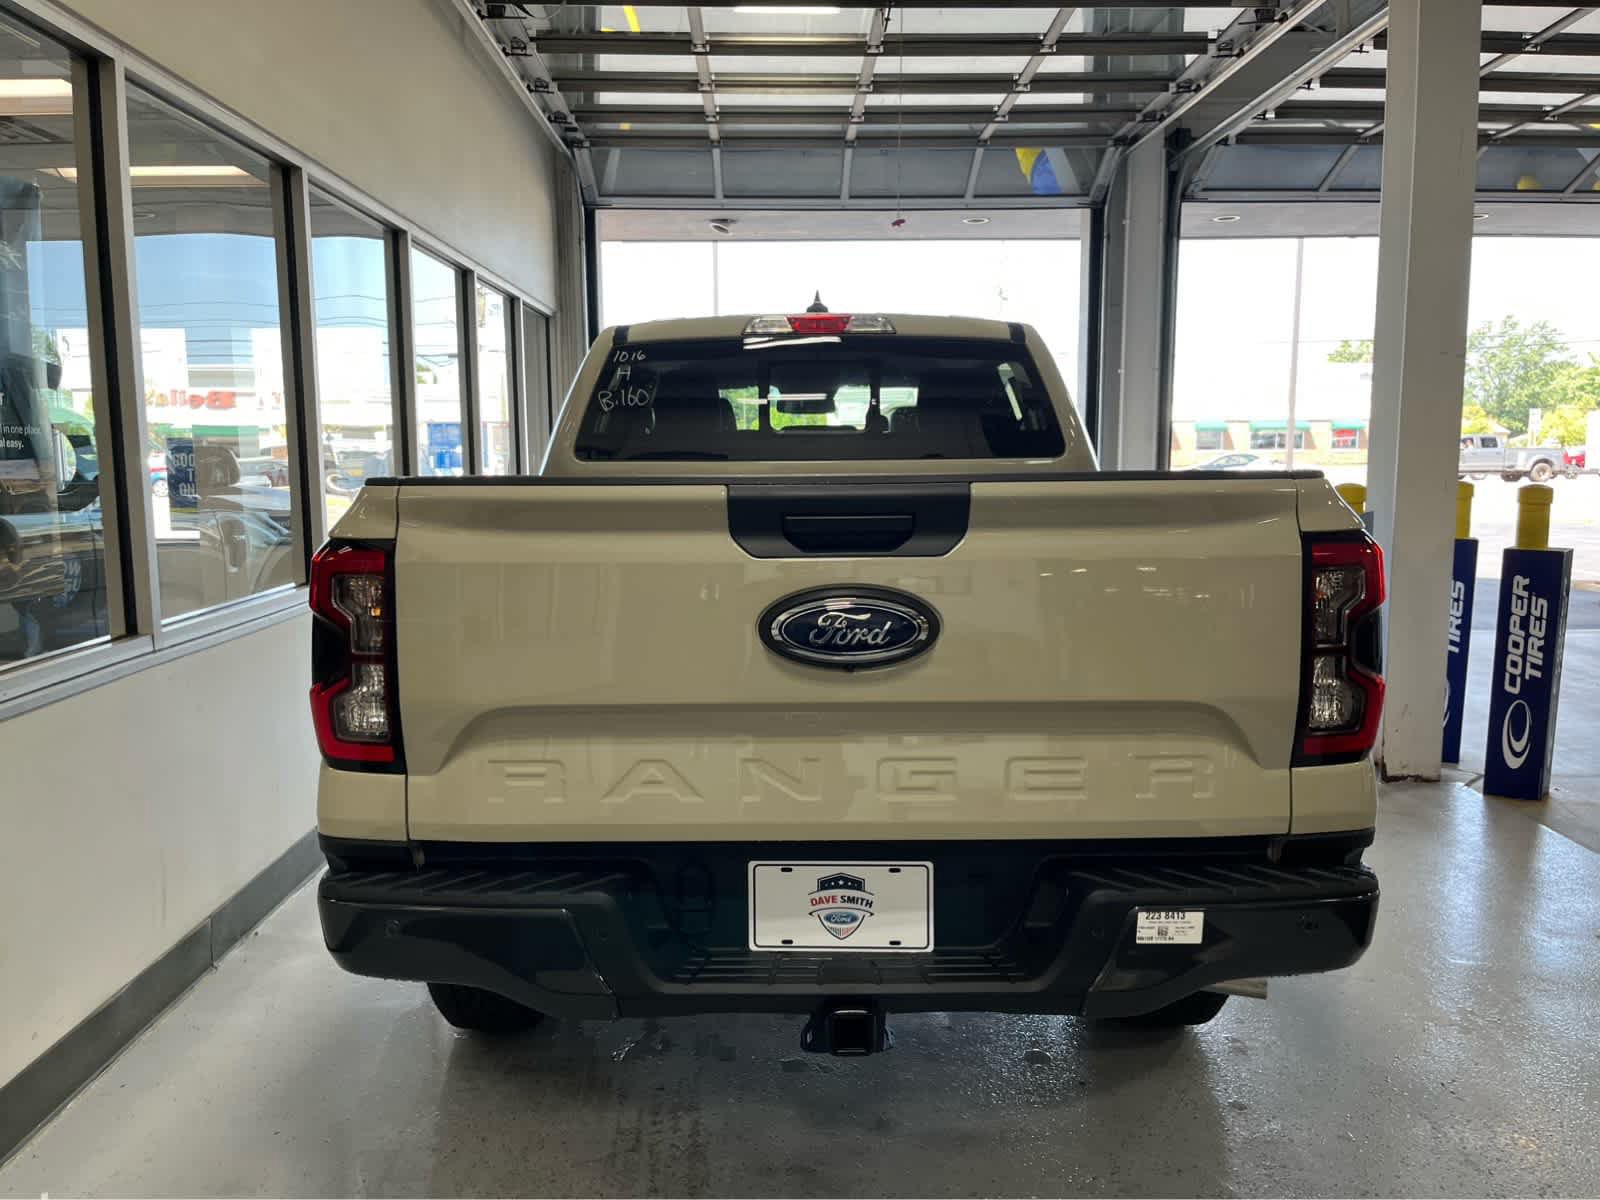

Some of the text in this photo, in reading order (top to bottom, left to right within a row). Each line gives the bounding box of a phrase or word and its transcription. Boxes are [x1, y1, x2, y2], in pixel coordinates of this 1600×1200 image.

[808, 611, 892, 645] Ford
[1504, 574, 1531, 695] COOPER
[1525, 596, 1548, 680] TIRES
[486, 752, 1217, 804] RANGER
[810, 895, 874, 909] DAVE SMITH
[1145, 911, 1162, 920] 223
